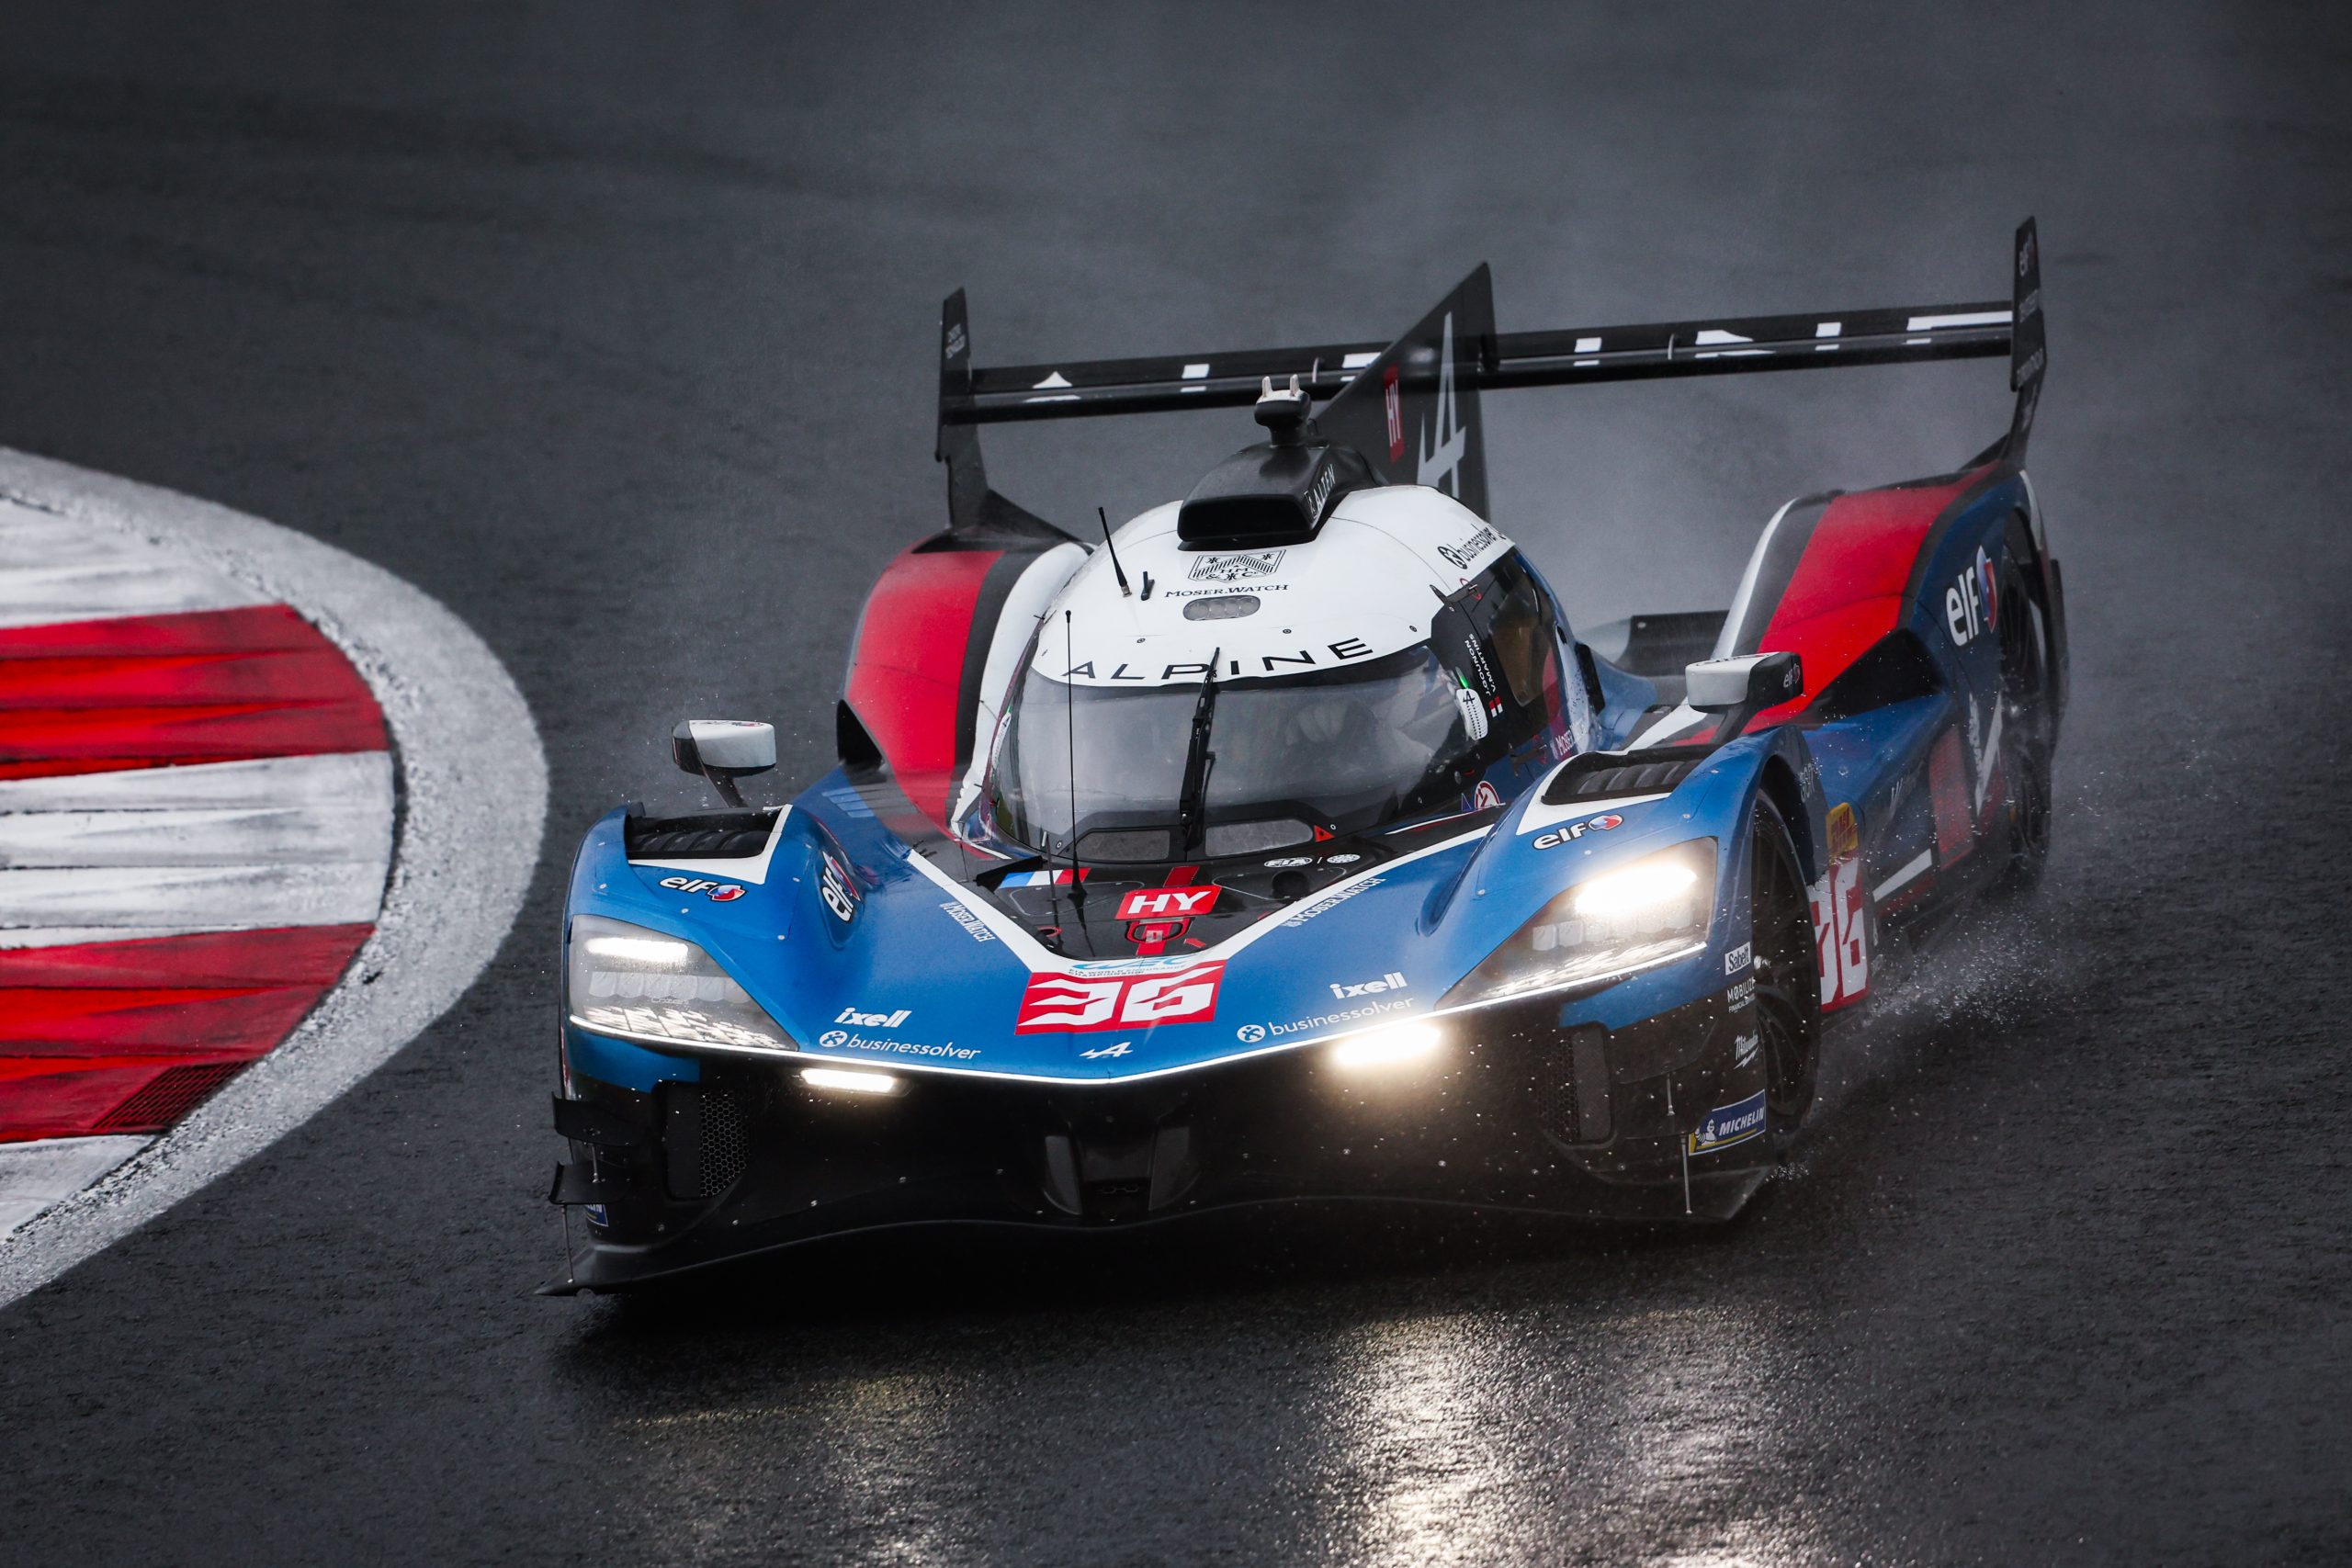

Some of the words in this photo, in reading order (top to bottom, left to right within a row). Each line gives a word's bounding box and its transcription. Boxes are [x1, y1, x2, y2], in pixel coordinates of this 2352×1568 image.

[1385, 379, 1401, 447] HY
[1313, 464, 1336, 512] ALTEN
[1446, 523, 1498, 562] businessolver
[1164, 584, 1289, 598] MOSER.WATCH
[1946, 566, 1979, 647] elf
[1061, 637, 1374, 680] ALPINE
[1464, 639, 1491, 696] J.GOUNON
[1469, 633, 1497, 693] V.MARTINS
[1783, 668, 1792, 688] elf
[1532, 822, 1587, 850] elf
[660, 876, 718, 893] elf
[822, 866, 854, 921] elf
[1127, 890, 1212, 914] HY
[1728, 945, 1749, 972] Sabelt
[1017, 964, 1226, 1026] 36
[1329, 972, 1408, 999] ixell
[833, 1007, 912, 1028] ixell
[1268, 998, 1415, 1036] businessolver
[846, 1033, 982, 1061] businessolver
[1718, 1106, 1765, 1136] MICHELIN
